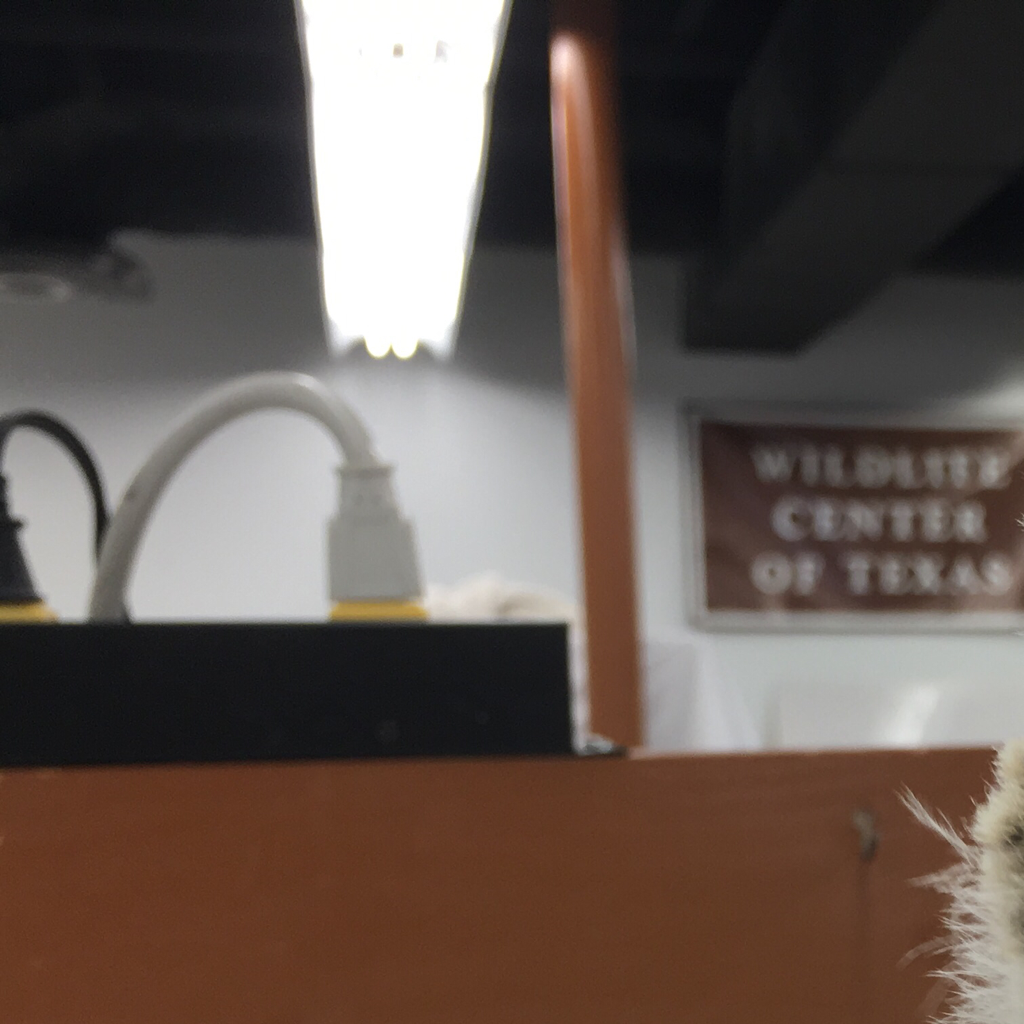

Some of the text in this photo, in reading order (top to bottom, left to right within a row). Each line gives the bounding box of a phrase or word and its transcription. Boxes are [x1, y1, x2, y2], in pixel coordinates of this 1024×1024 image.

[752, 446, 1009, 488] WILDLIFE
[771, 498, 987, 542] CENTER
[750, 553, 1013, 595] OF TEXAS
